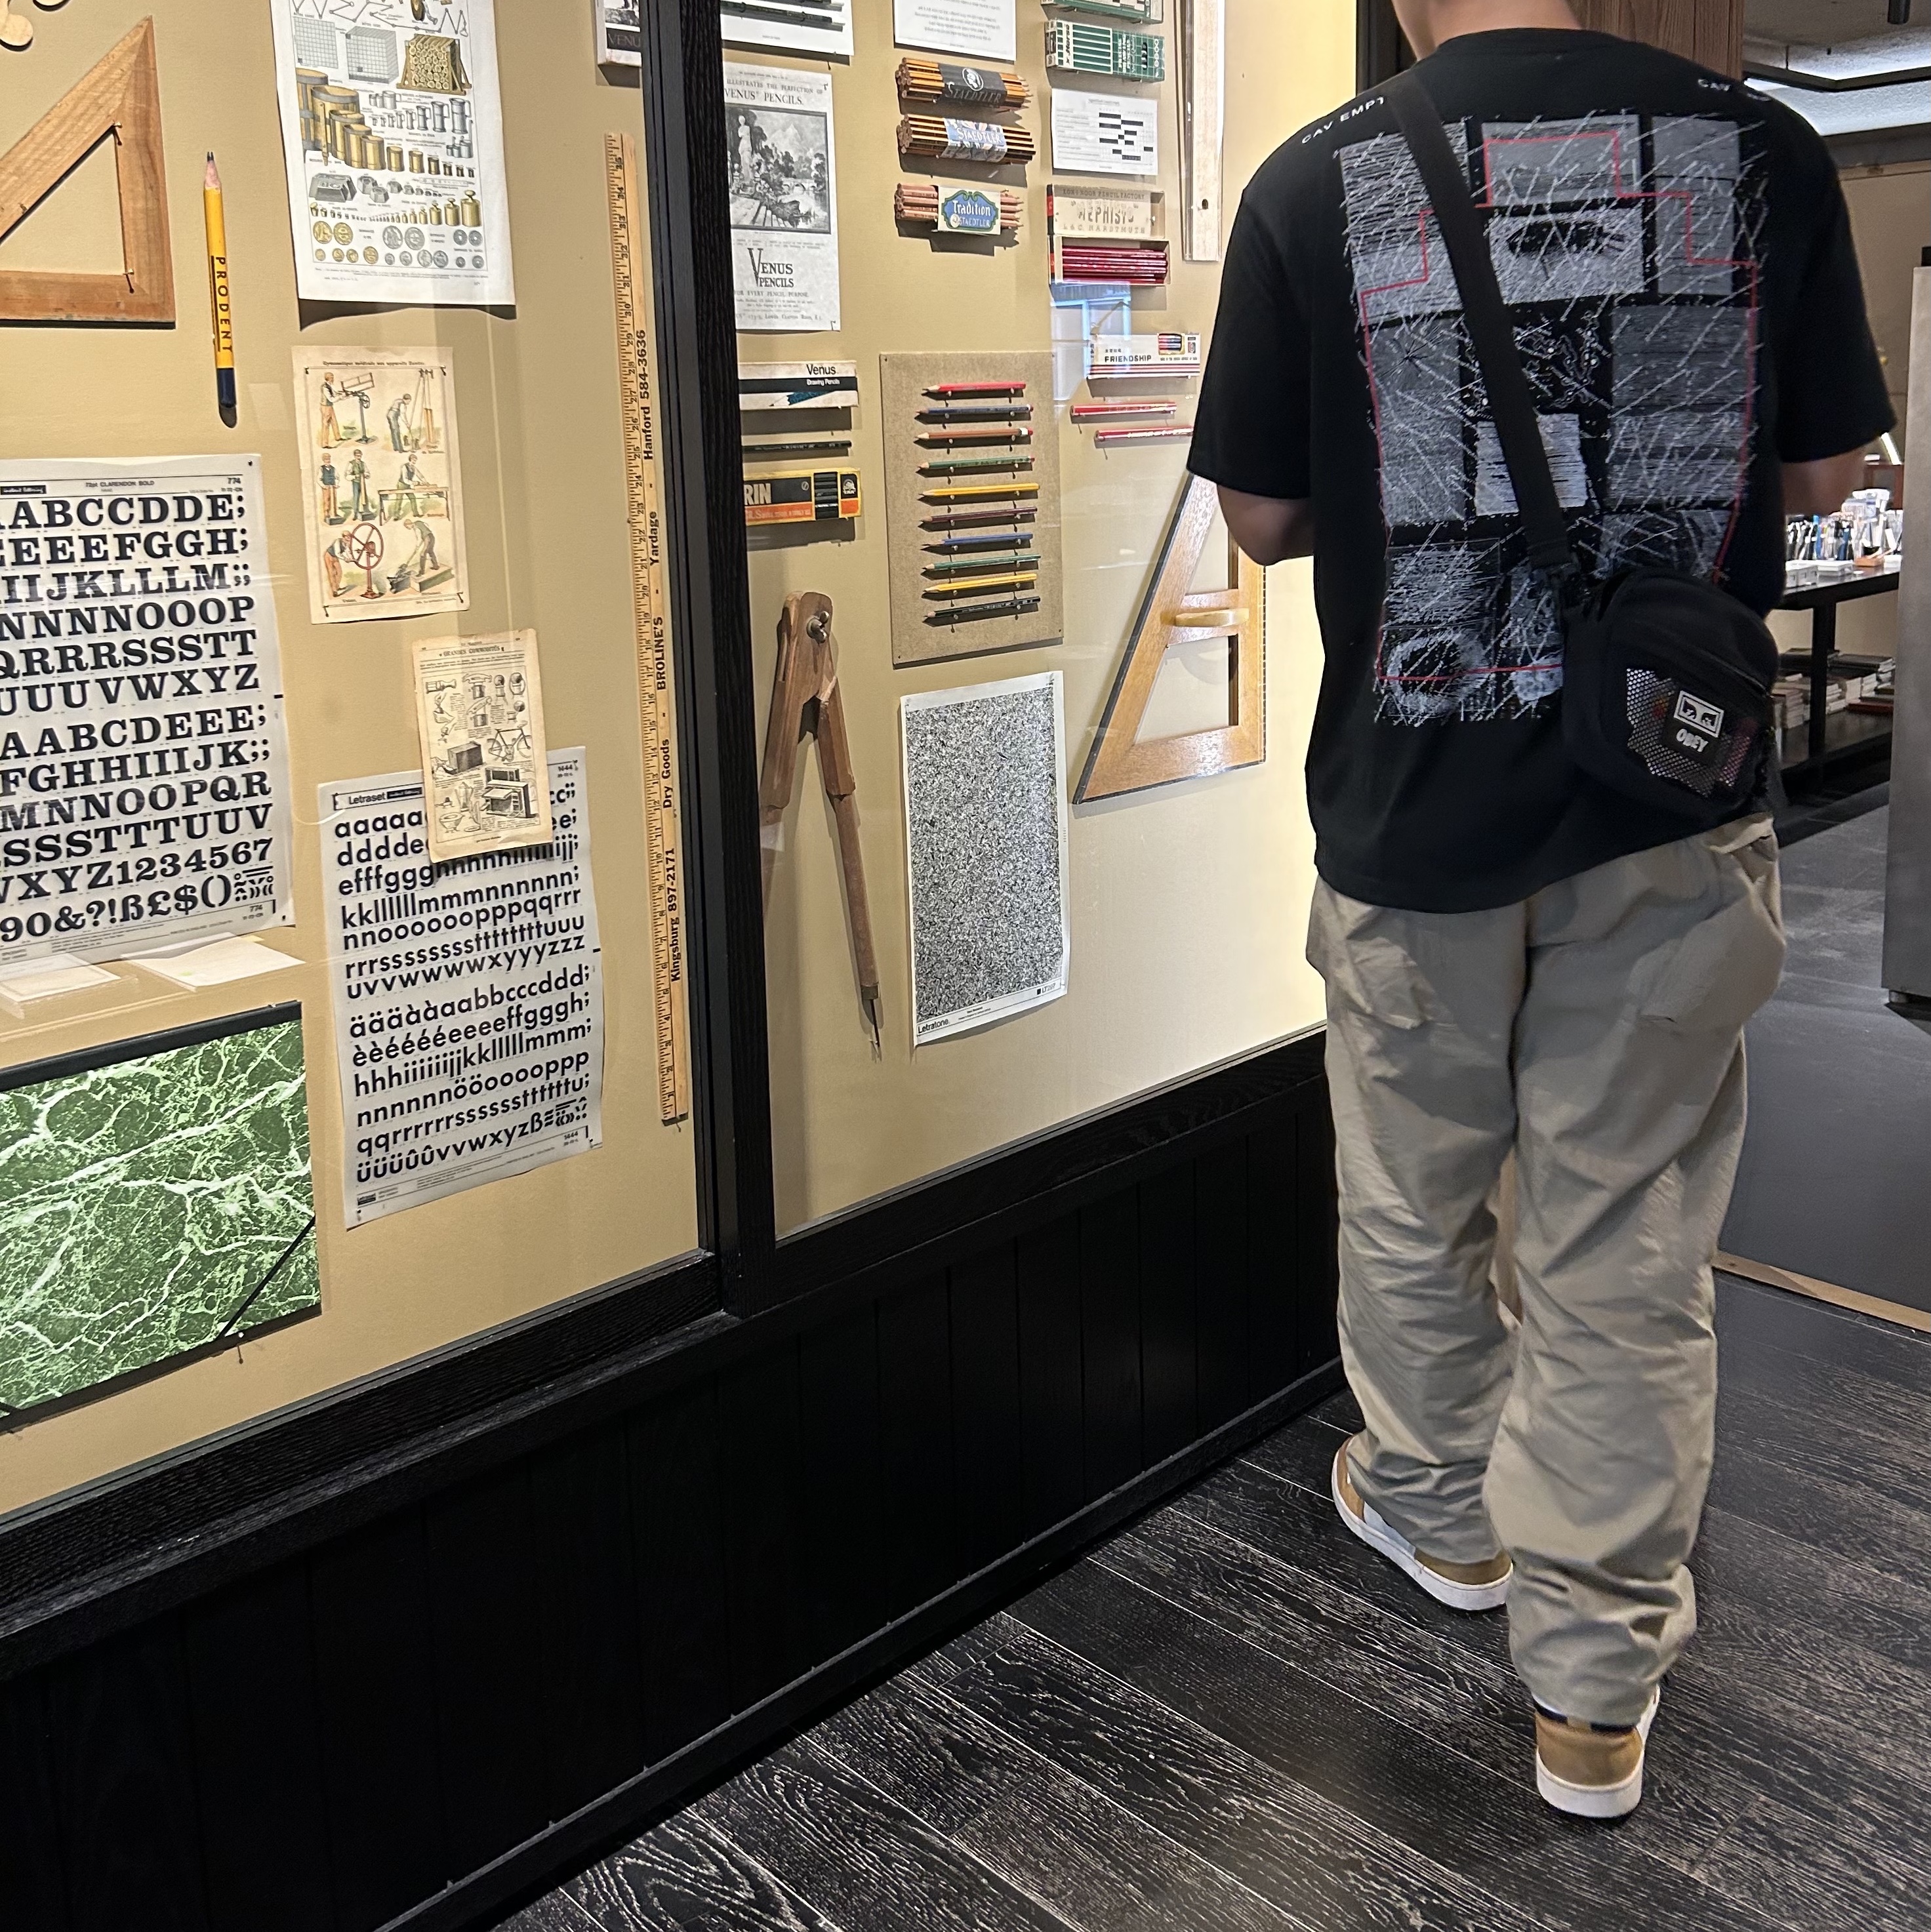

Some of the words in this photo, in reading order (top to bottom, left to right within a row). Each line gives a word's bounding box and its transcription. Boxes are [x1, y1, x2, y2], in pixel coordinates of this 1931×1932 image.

[958, 127, 1002, 144] STAEDTLER
[1301, 120, 1333, 144] CAV
[952, 199, 991, 216] Tradition
[759, 277, 794, 288] PENCILS
[215, 256, 233, 353] PRODENT
[636, 329, 650, 400] 584-3636
[806, 363, 836, 375] Venus
[1105, 354, 1152, 363] FRIENDSHIP
[640, 406, 653, 460] Hanford
[649, 511, 660, 566] Yardage
[653, 616, 667, 691] BROLINE'S
[1676, 728, 1709, 752] OBEY
[660, 738, 671, 779] Goods
[348, 790, 386, 805] Letraset
[662, 786, 674, 809] Dry
[665, 847, 677, 912] 897-2171
[670, 917, 681, 982] Kingsburg
[918, 1018, 949, 1034] Letratone
